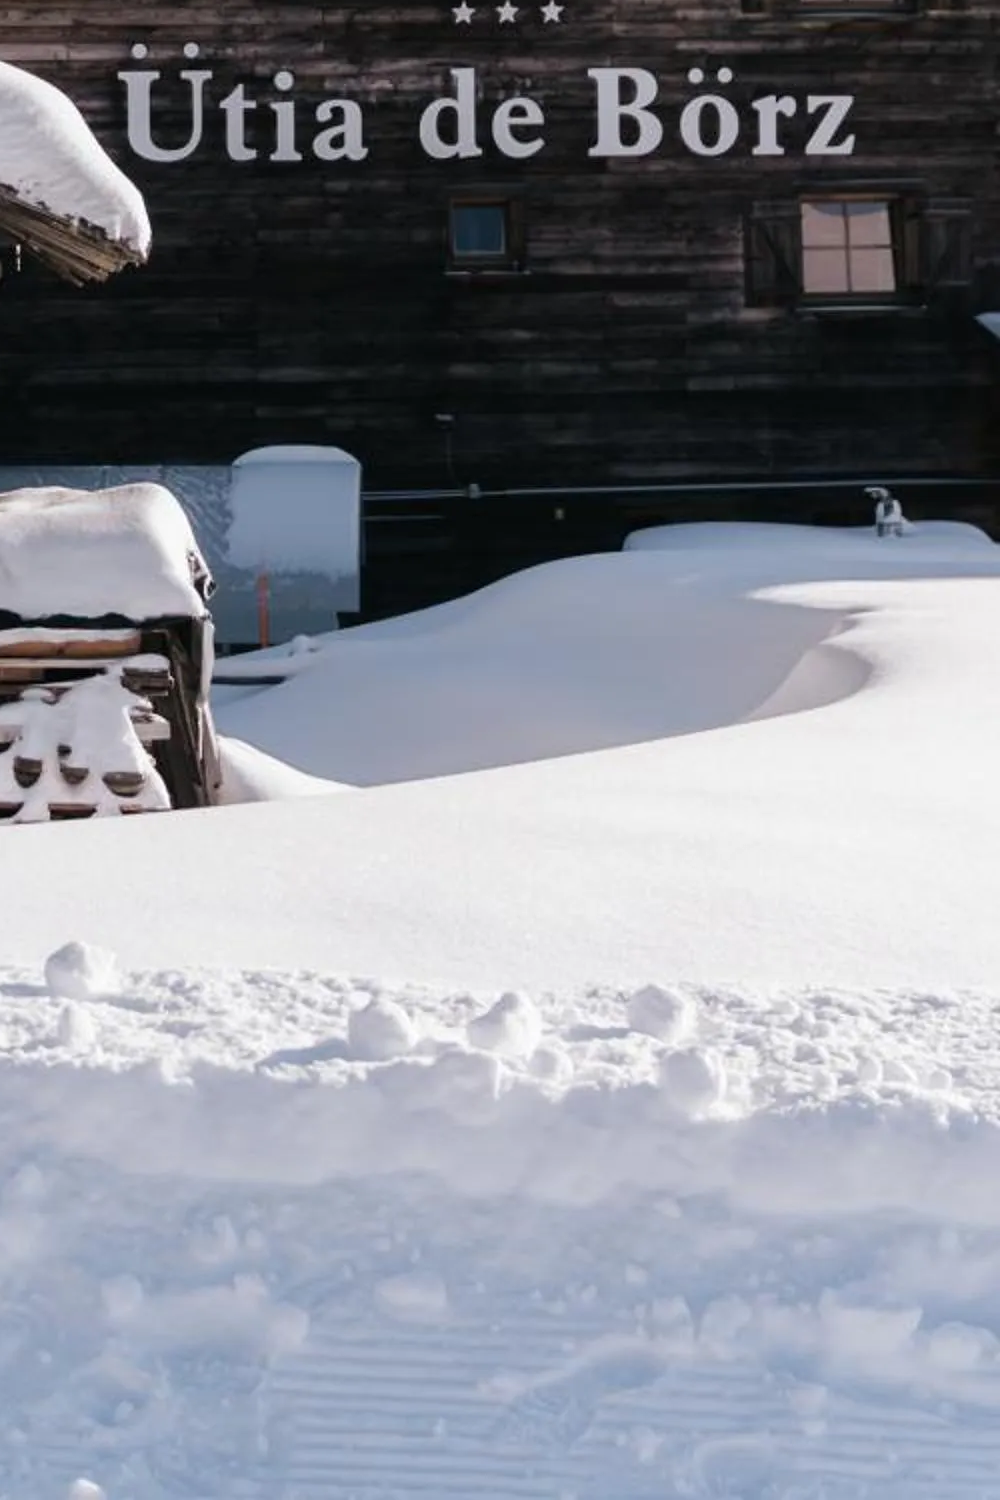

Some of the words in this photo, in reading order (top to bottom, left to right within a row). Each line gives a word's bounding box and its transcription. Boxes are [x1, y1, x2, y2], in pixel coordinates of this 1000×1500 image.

[117, 42, 369, 162] Ütia
[419, 67, 545, 159] de
[587, 67, 856, 158] Börz
